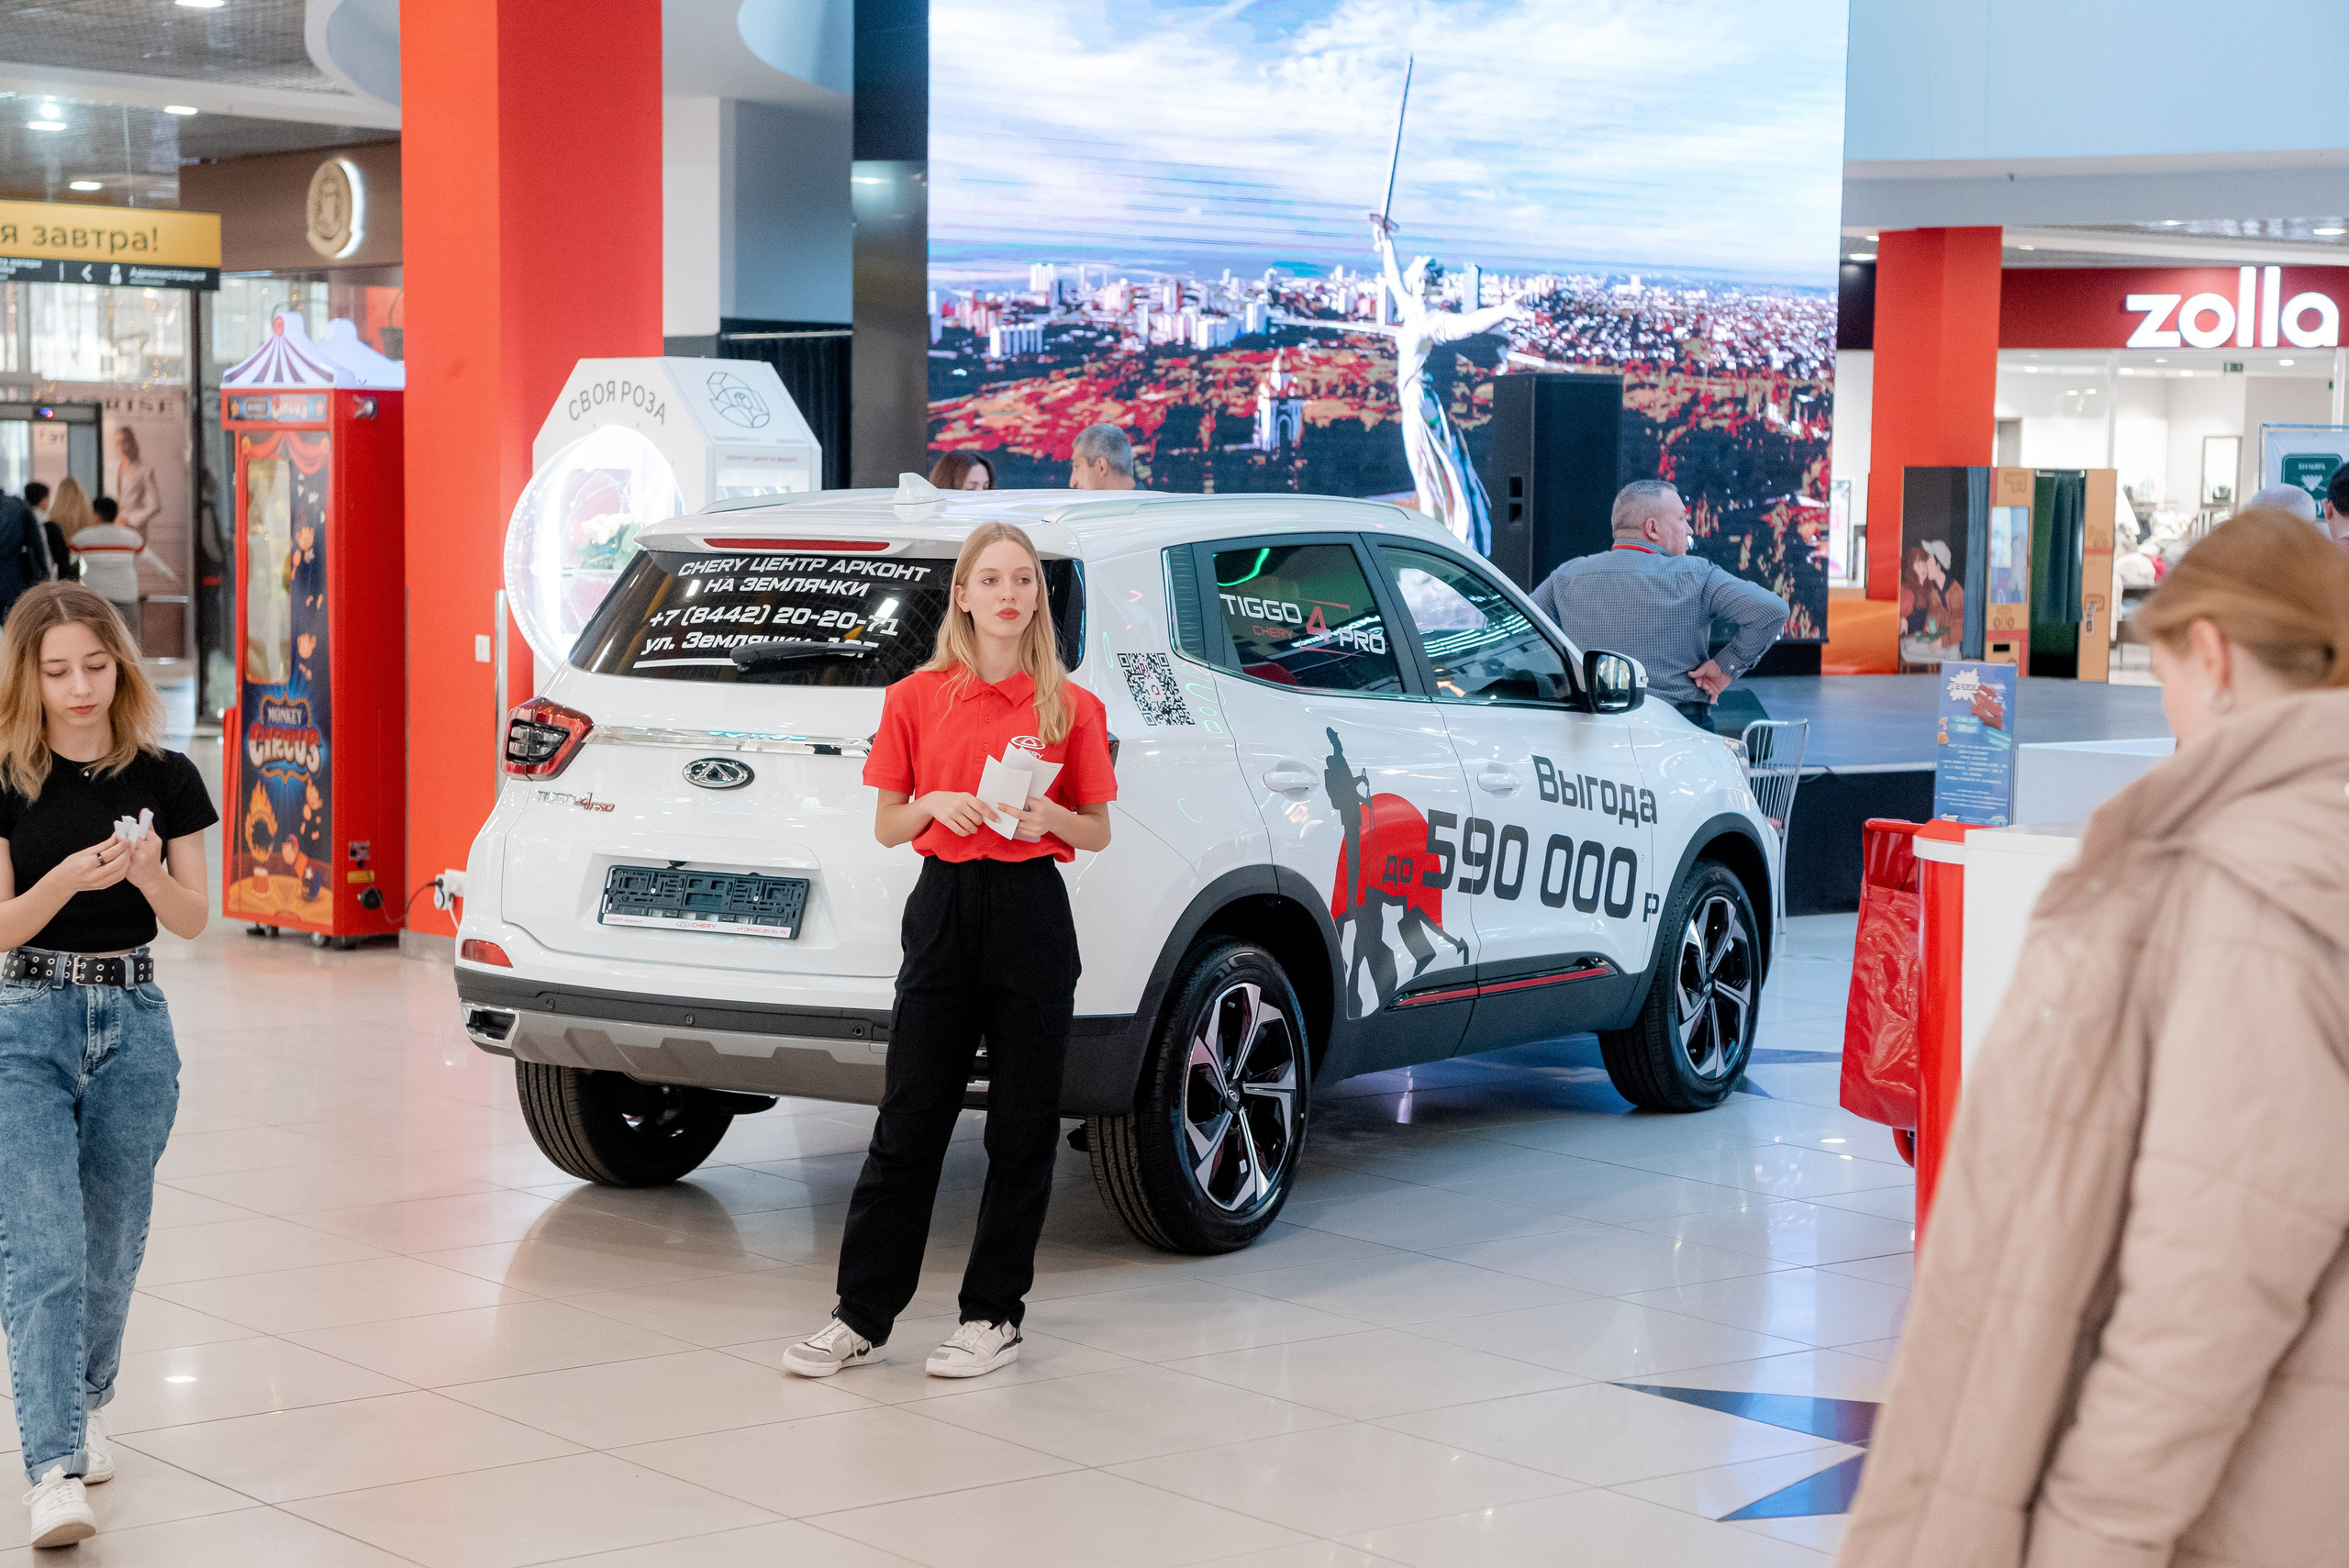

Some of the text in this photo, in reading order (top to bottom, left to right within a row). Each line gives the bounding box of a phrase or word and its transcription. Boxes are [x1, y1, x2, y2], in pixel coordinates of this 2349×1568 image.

[32, 225, 160, 255] завтра!
[2125, 265, 2340, 349] zolla
[568, 380, 666, 426] СВОЯ РОЗА
[677, 557, 931, 582] CHERY ЦЕНТР АРКОНТ
[703, 576, 871, 597] НА ЗЕМЛЯЧКИ
[649, 605, 900, 637] +7 (8442) 20-20-71
[1219, 594, 1303, 624] TIGGO
[1306, 606, 1331, 644] 4
[1339, 627, 1386, 655] PRO
[1252, 625, 1294, 640] CHERY
[640, 636, 674, 656] ул.
[267, 706, 303, 726] MONKEY
[249, 722, 321, 773] CIRCUS
[1531, 754, 1658, 828] Выгода
[1382, 854, 1414, 888] до
[1421, 808, 1530, 902] 590
[1540, 832, 1638, 919] 000
[691, 921, 718, 929] CHERY
